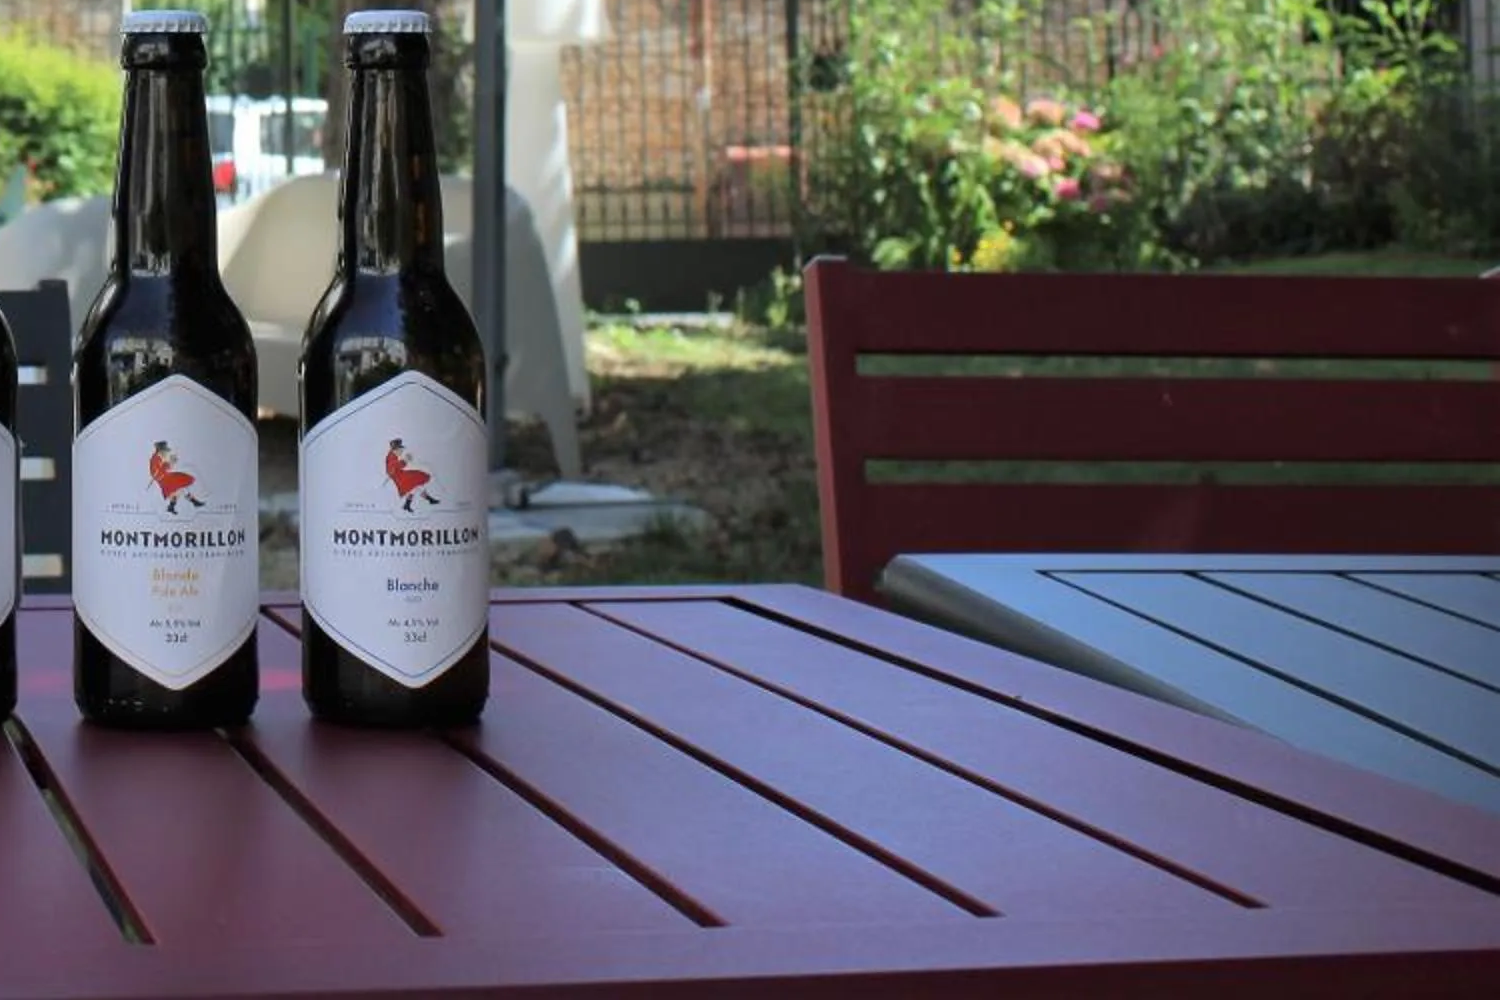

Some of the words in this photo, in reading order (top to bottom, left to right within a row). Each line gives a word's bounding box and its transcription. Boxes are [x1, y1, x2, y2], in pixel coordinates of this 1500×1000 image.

[100, 528, 245, 548] MONTMORILLON
[333, 527, 479, 547] MONTMORILLON
[387, 577, 440, 592] Blanche
